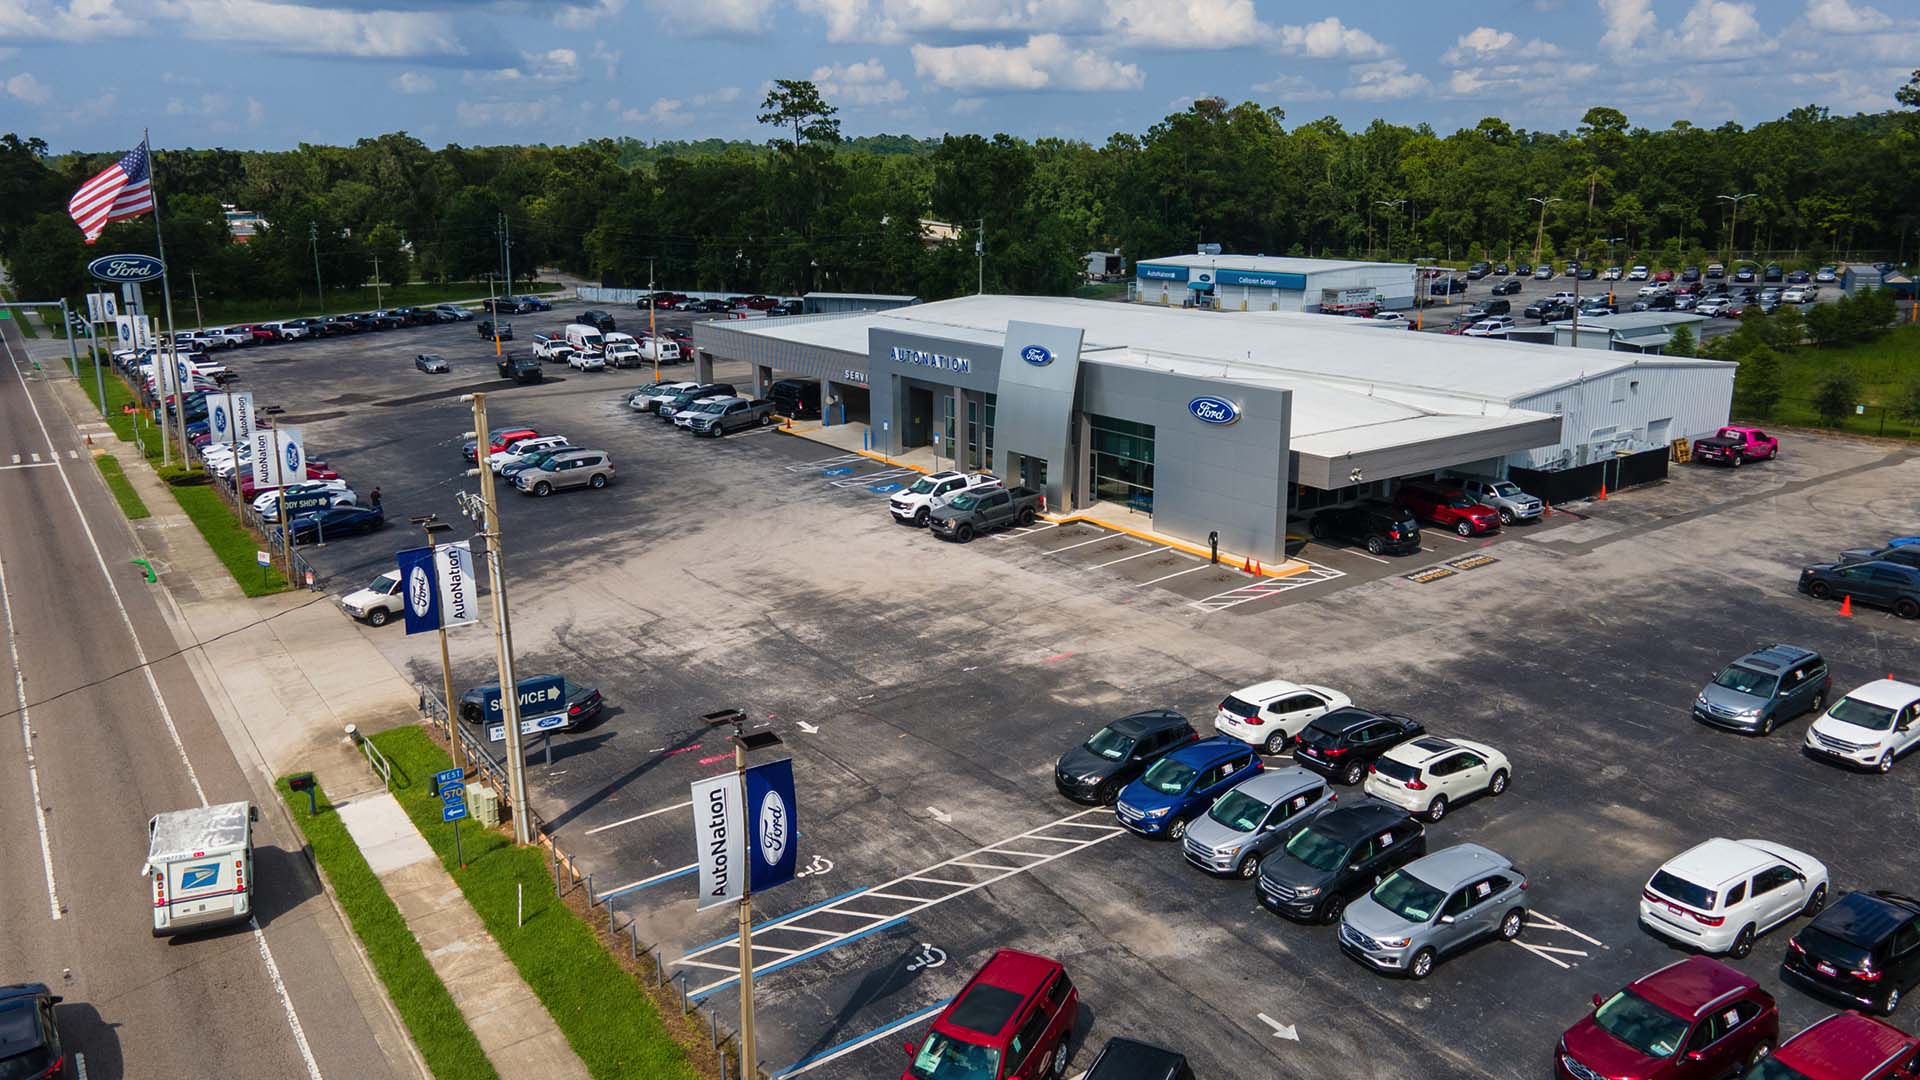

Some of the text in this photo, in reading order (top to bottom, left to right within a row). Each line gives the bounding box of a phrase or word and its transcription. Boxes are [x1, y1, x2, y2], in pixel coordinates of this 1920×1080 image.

[106, 260, 151, 277] Ford
[1238, 276, 1277, 286] Collision Center
[890, 347, 971, 373] AUTONATION
[1026, 349, 1045, 361] Ford
[844, 369, 868, 384] SERVI
[239, 396, 248, 438] AutoNation
[1197, 401, 1225, 420] Ford
[259, 435, 269, 484] AutoNation
[282, 499, 317, 510] ODY SHOP
[412, 576, 428, 607] Ford
[448, 550, 465, 620] AutoNation
[490, 690, 546, 711] SVICE
[440, 770, 460, 781] WEST
[443, 787, 464, 800] 570
[764, 806, 782, 851] Ford
[709, 788, 728, 897] AutoNation
